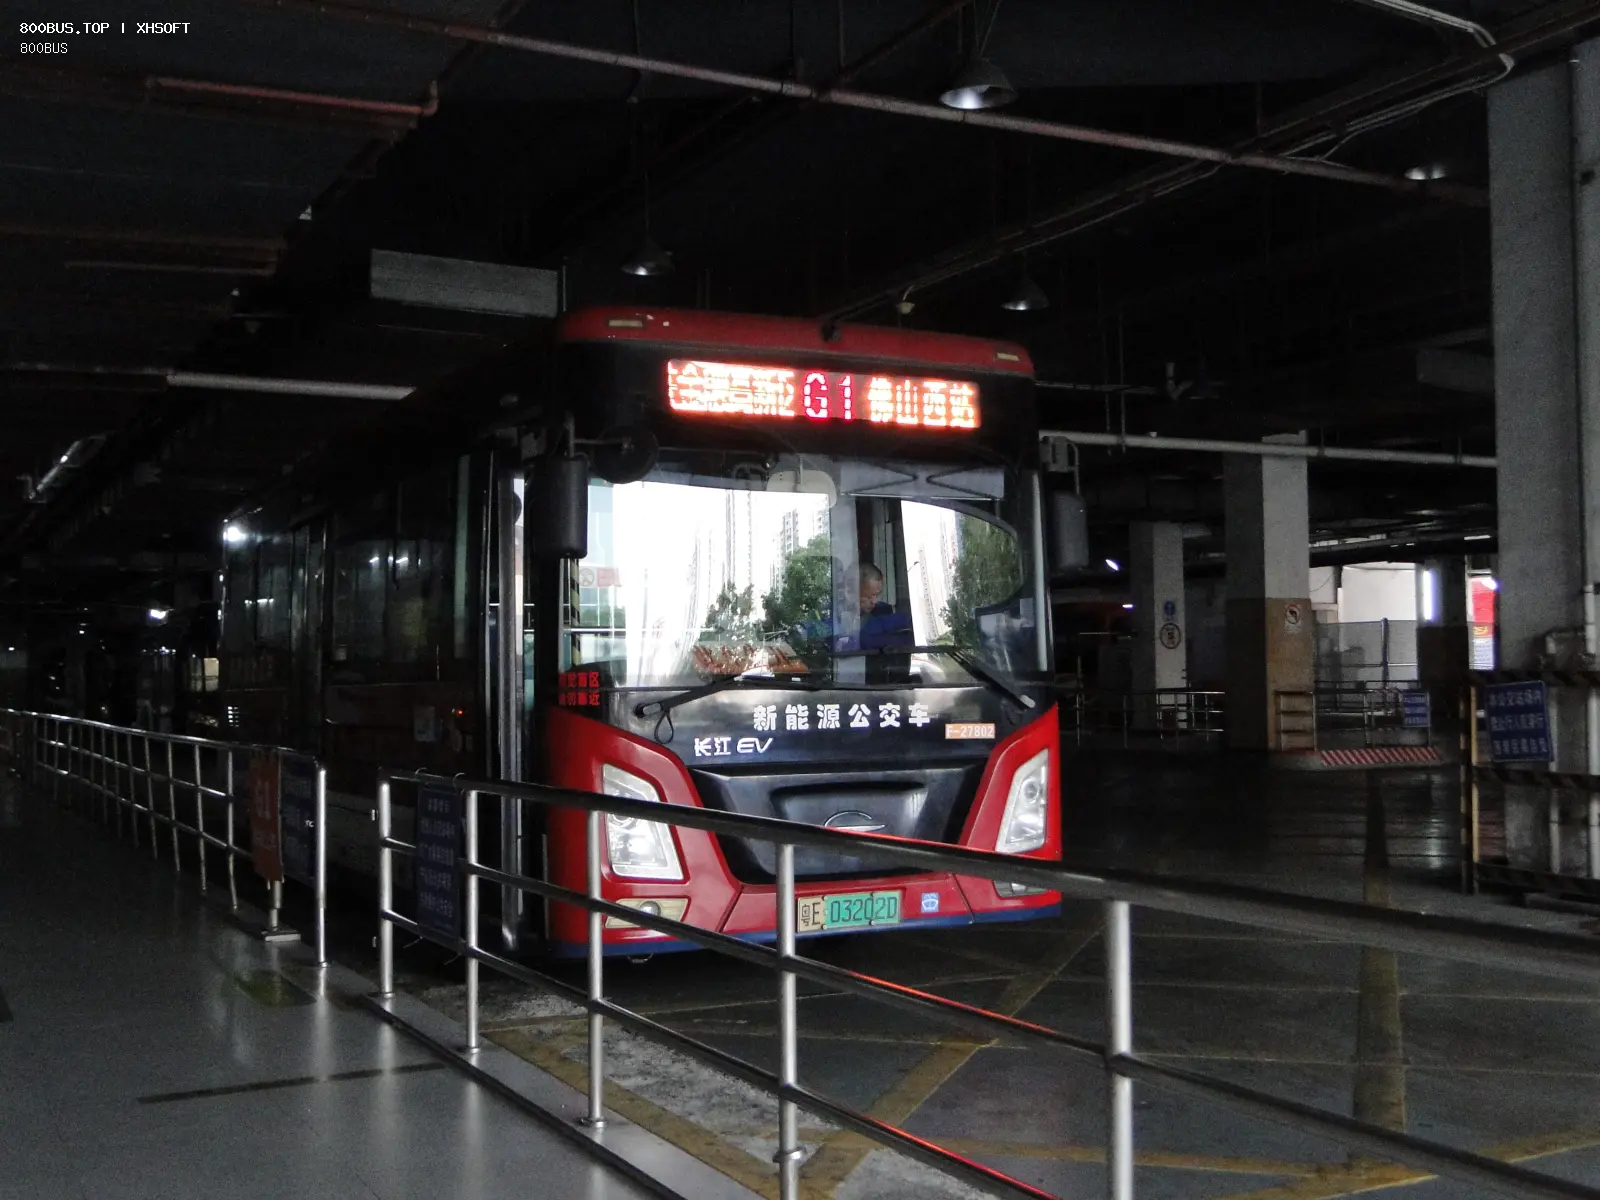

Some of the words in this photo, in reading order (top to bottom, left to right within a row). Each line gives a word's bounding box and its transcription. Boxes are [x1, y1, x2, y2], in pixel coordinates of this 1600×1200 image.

[803, 372, 853, 420] G1
[752, 703, 931, 731] 新能源公交车
[945, 724, 995, 739] F-27802
[694, 736, 731, 757] 长江
[736, 737, 773, 754] EV
